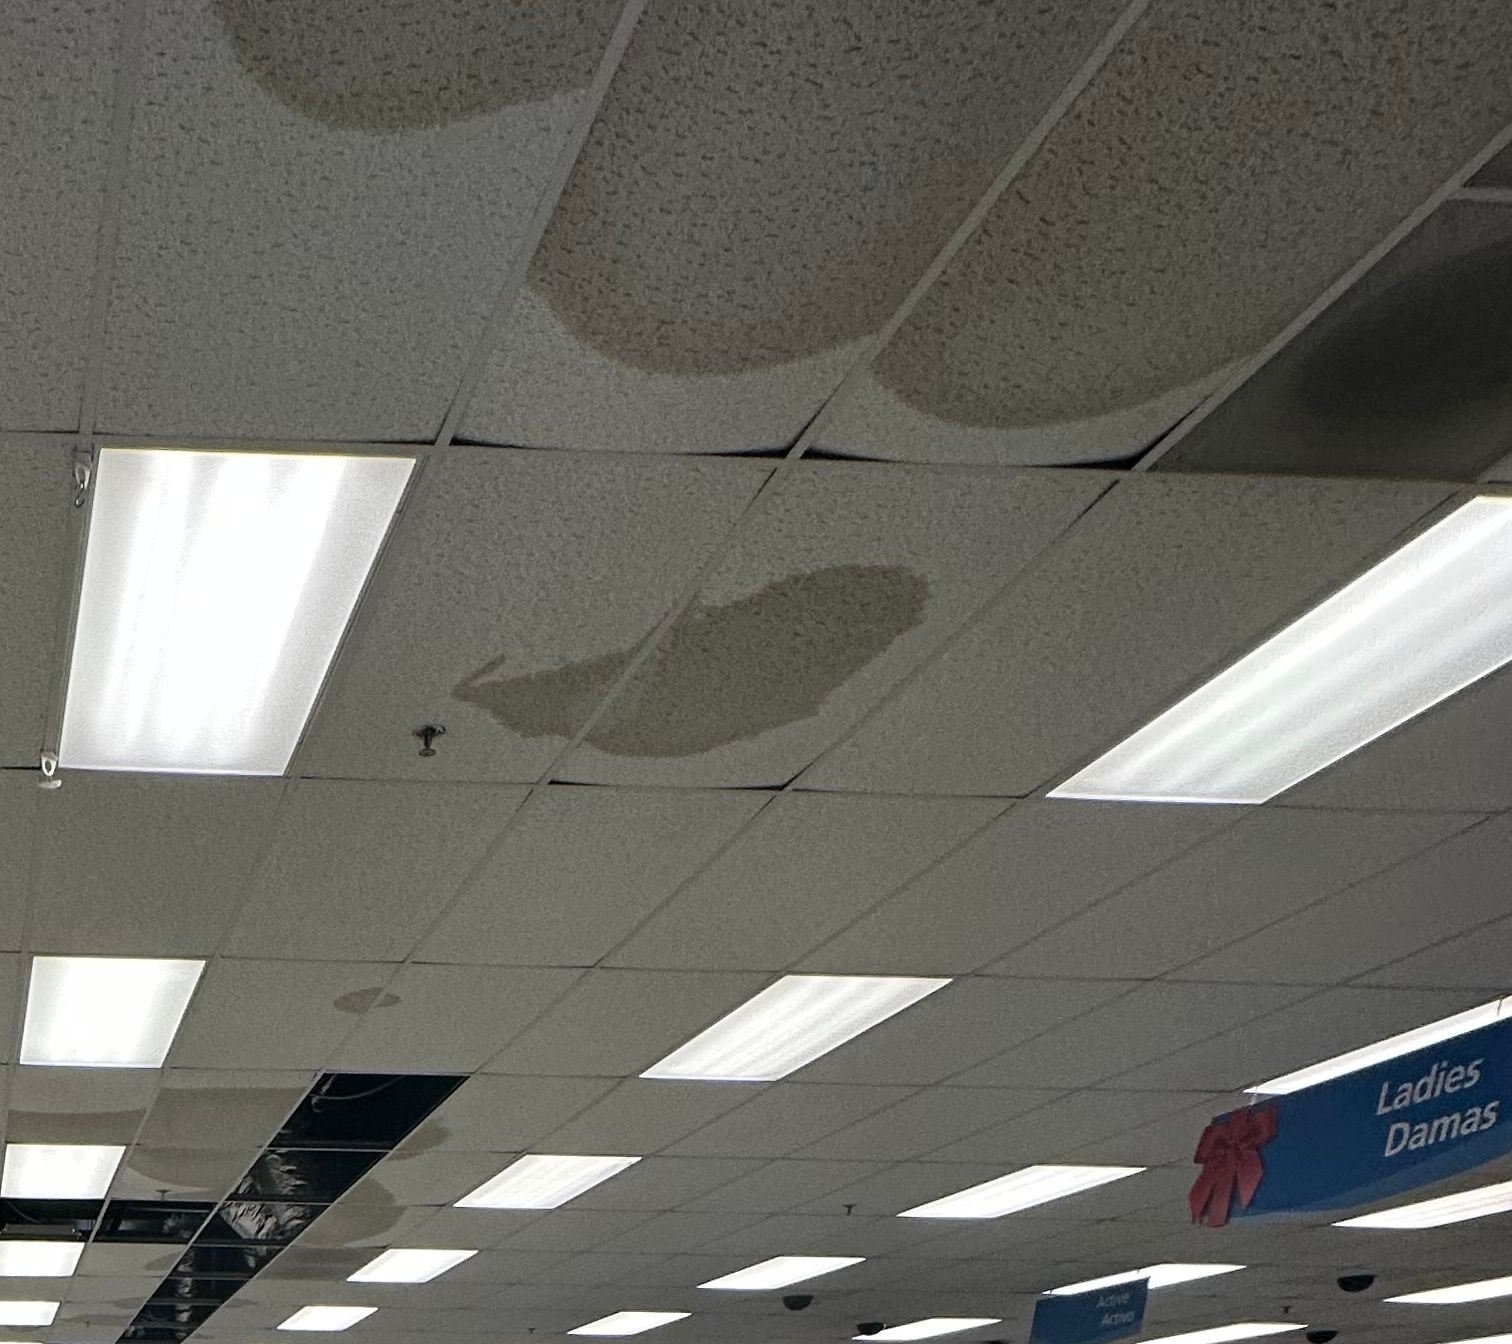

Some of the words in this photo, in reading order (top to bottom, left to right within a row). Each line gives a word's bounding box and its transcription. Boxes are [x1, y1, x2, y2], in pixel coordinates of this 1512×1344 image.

[1377, 1057, 1484, 1115] Ladies
[1385, 1100, 1500, 1157] Damas
[1096, 1293, 1131, 1308] Active
[1100, 1311, 1135, 1326] Activo
